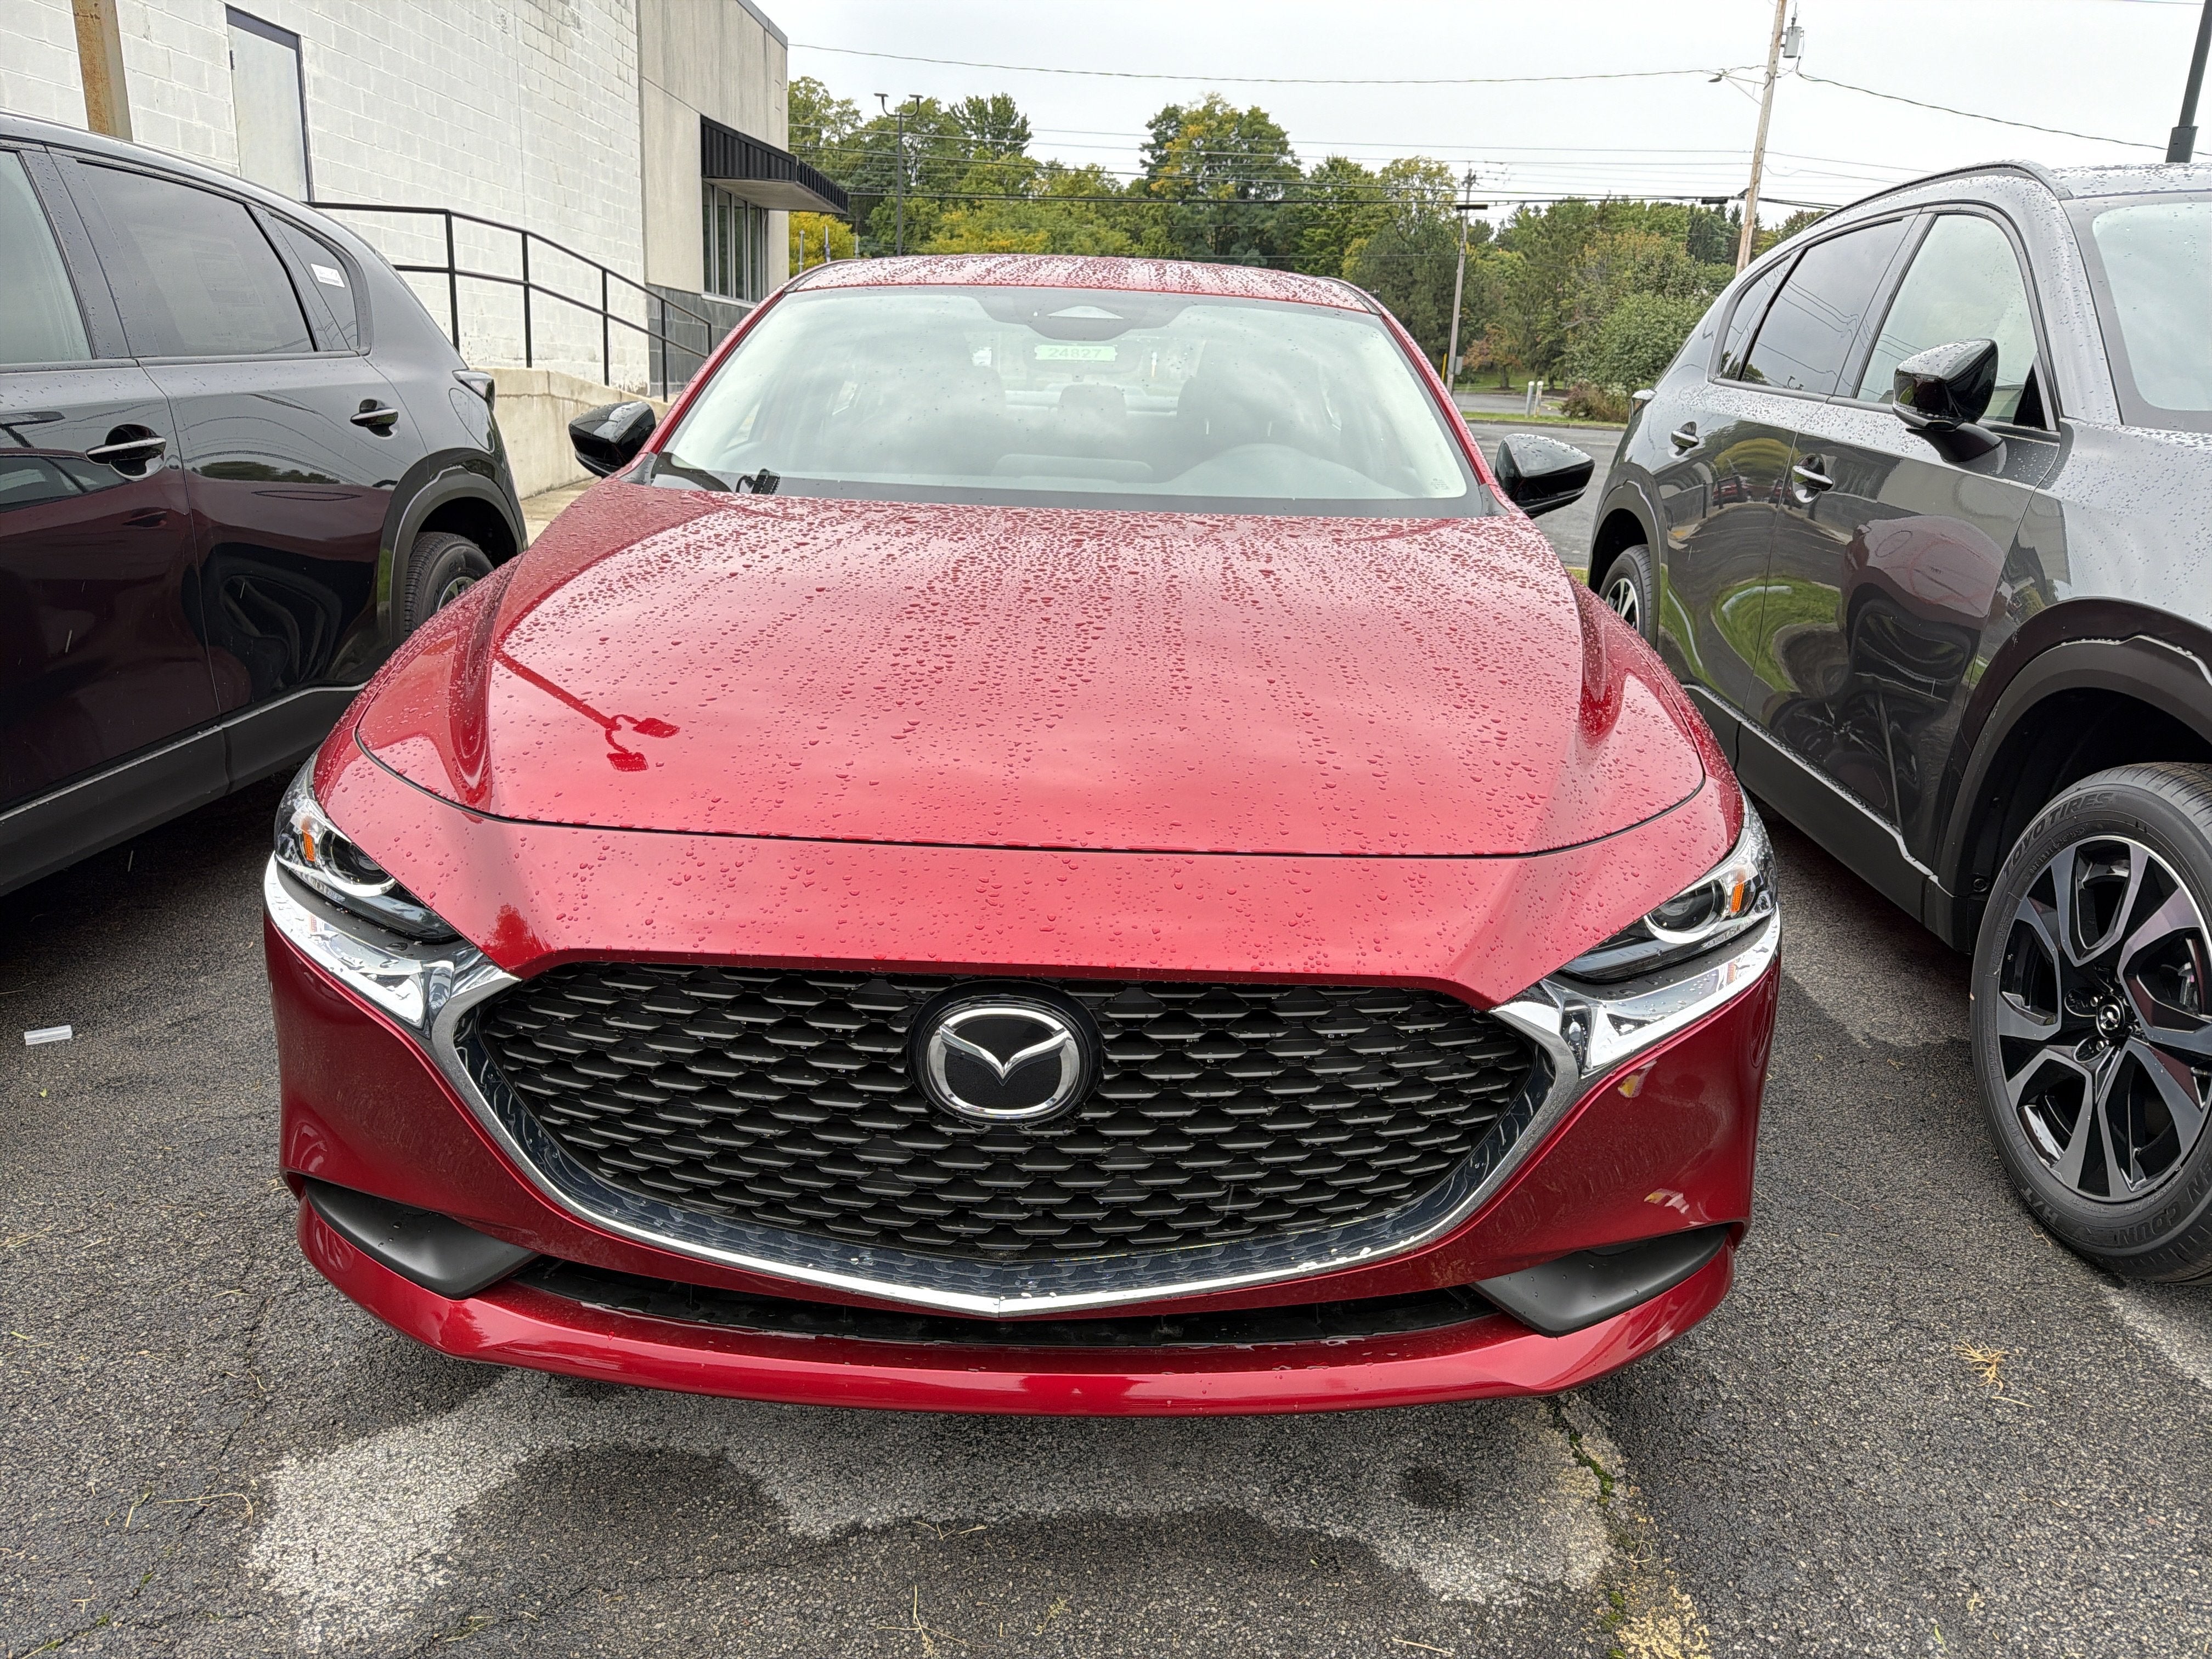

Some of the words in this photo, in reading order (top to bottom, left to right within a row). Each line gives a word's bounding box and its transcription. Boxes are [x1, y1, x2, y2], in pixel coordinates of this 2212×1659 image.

[1048, 348, 1102, 358] 24827
[2003, 818, 2046, 880] TOYO
[2050, 793, 2114, 825] TIRES
